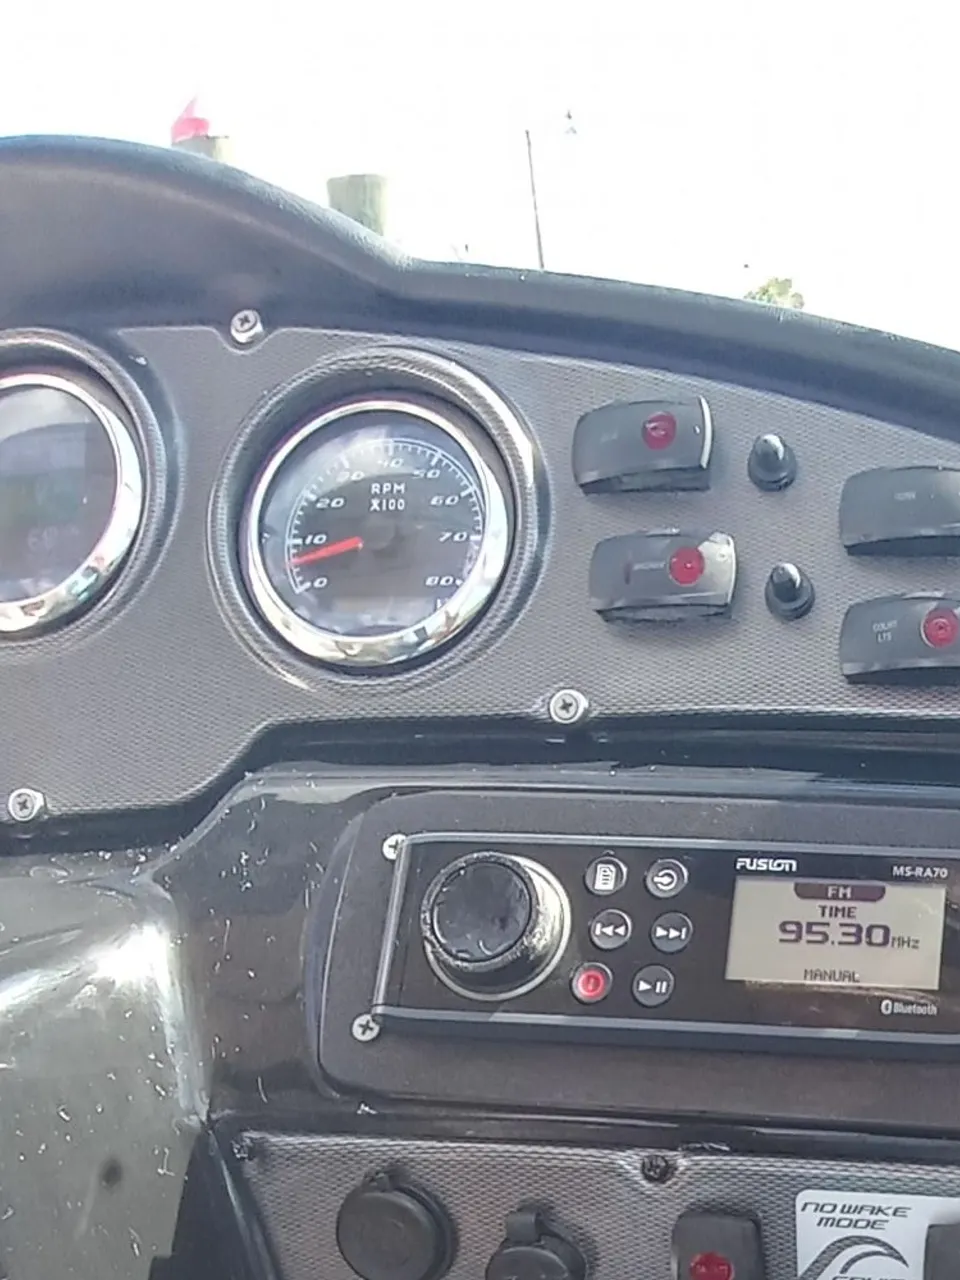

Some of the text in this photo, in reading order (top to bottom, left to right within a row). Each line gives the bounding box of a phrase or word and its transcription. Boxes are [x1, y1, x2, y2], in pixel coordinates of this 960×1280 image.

[411, 468, 441, 480] 50
[370, 482, 406, 496] RPM
[315, 497, 346, 509] 20
[370, 498, 406, 511] X100
[430, 495, 460, 507] 60
[302, 533, 327, 545] 10
[438, 531, 468, 542] 70
[311, 576, 328, 589] 0
[425, 576, 454, 587] 80
[735, 857, 798, 873] FUSION
[892, 865, 949, 879] MS-RA70
[826, 885, 852, 900] FM
[817, 904, 857, 919] TIME
[778, 920, 920, 950] 95.30 MHz
[803, 968, 861, 983] MANUAL
[893, 1002, 938, 1017] Bluetooth
[799, 1201, 913, 1219] NO WAKE
[815, 1216, 891, 1231] MODE
